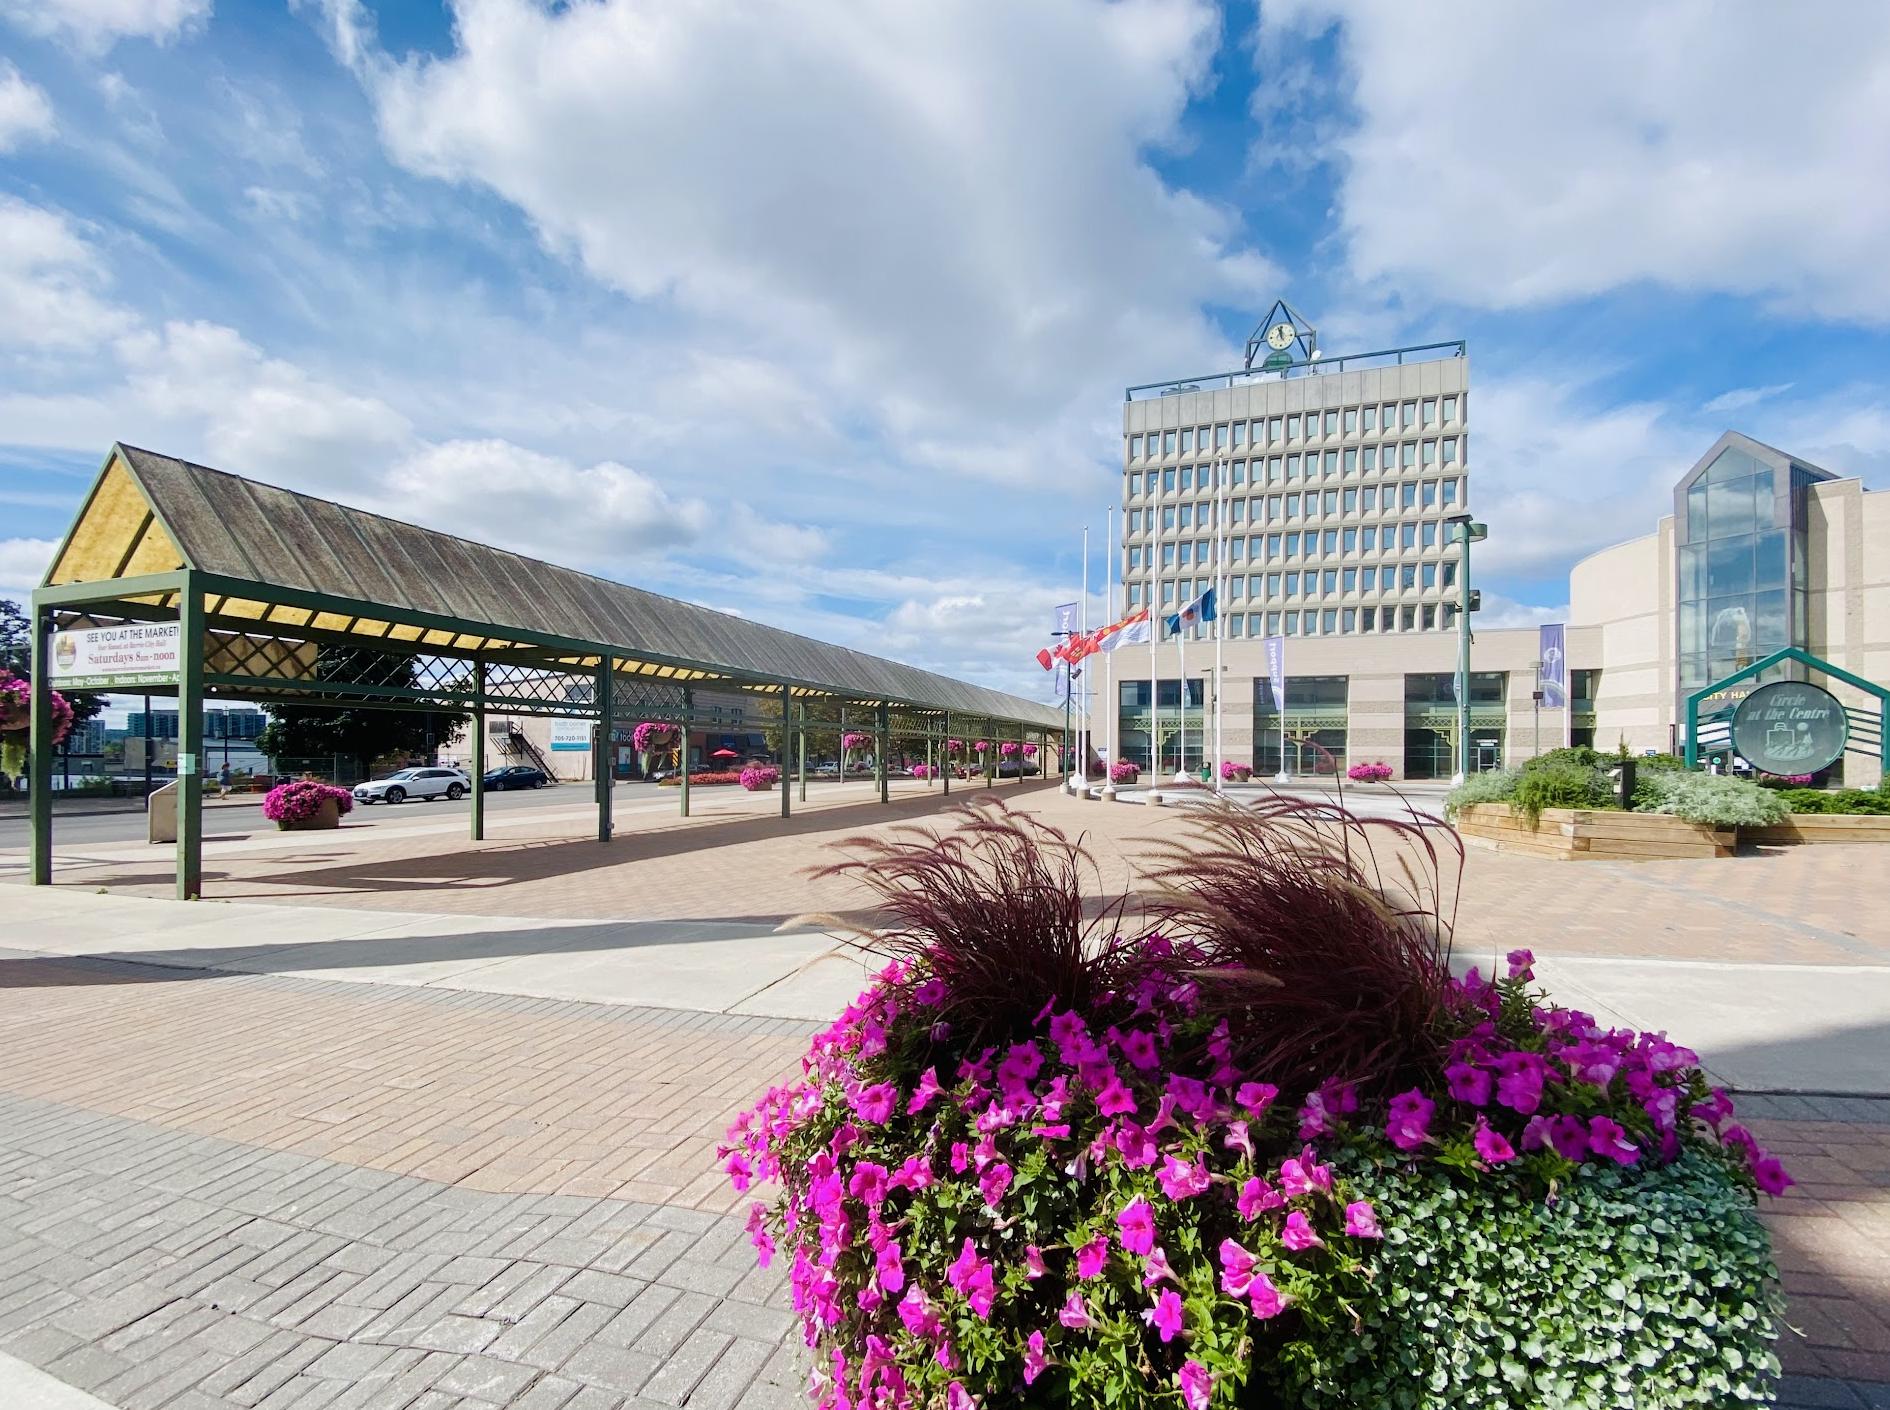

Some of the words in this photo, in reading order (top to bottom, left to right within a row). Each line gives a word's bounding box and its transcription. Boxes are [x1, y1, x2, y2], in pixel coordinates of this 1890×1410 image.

[87, 632, 98, 642] SEE
[101, 631, 117, 641] YOU
[120, 630, 128, 640] AT
[130, 629, 143, 639] THE
[145, 626, 179, 637] MARKET!
[88, 651, 134, 664] Saturdays
[1769, 693, 1807, 707] Circle
[1746, 709, 1762, 720] at
[1764, 707, 1785, 720] the
[1788, 707, 1831, 719] Centre
